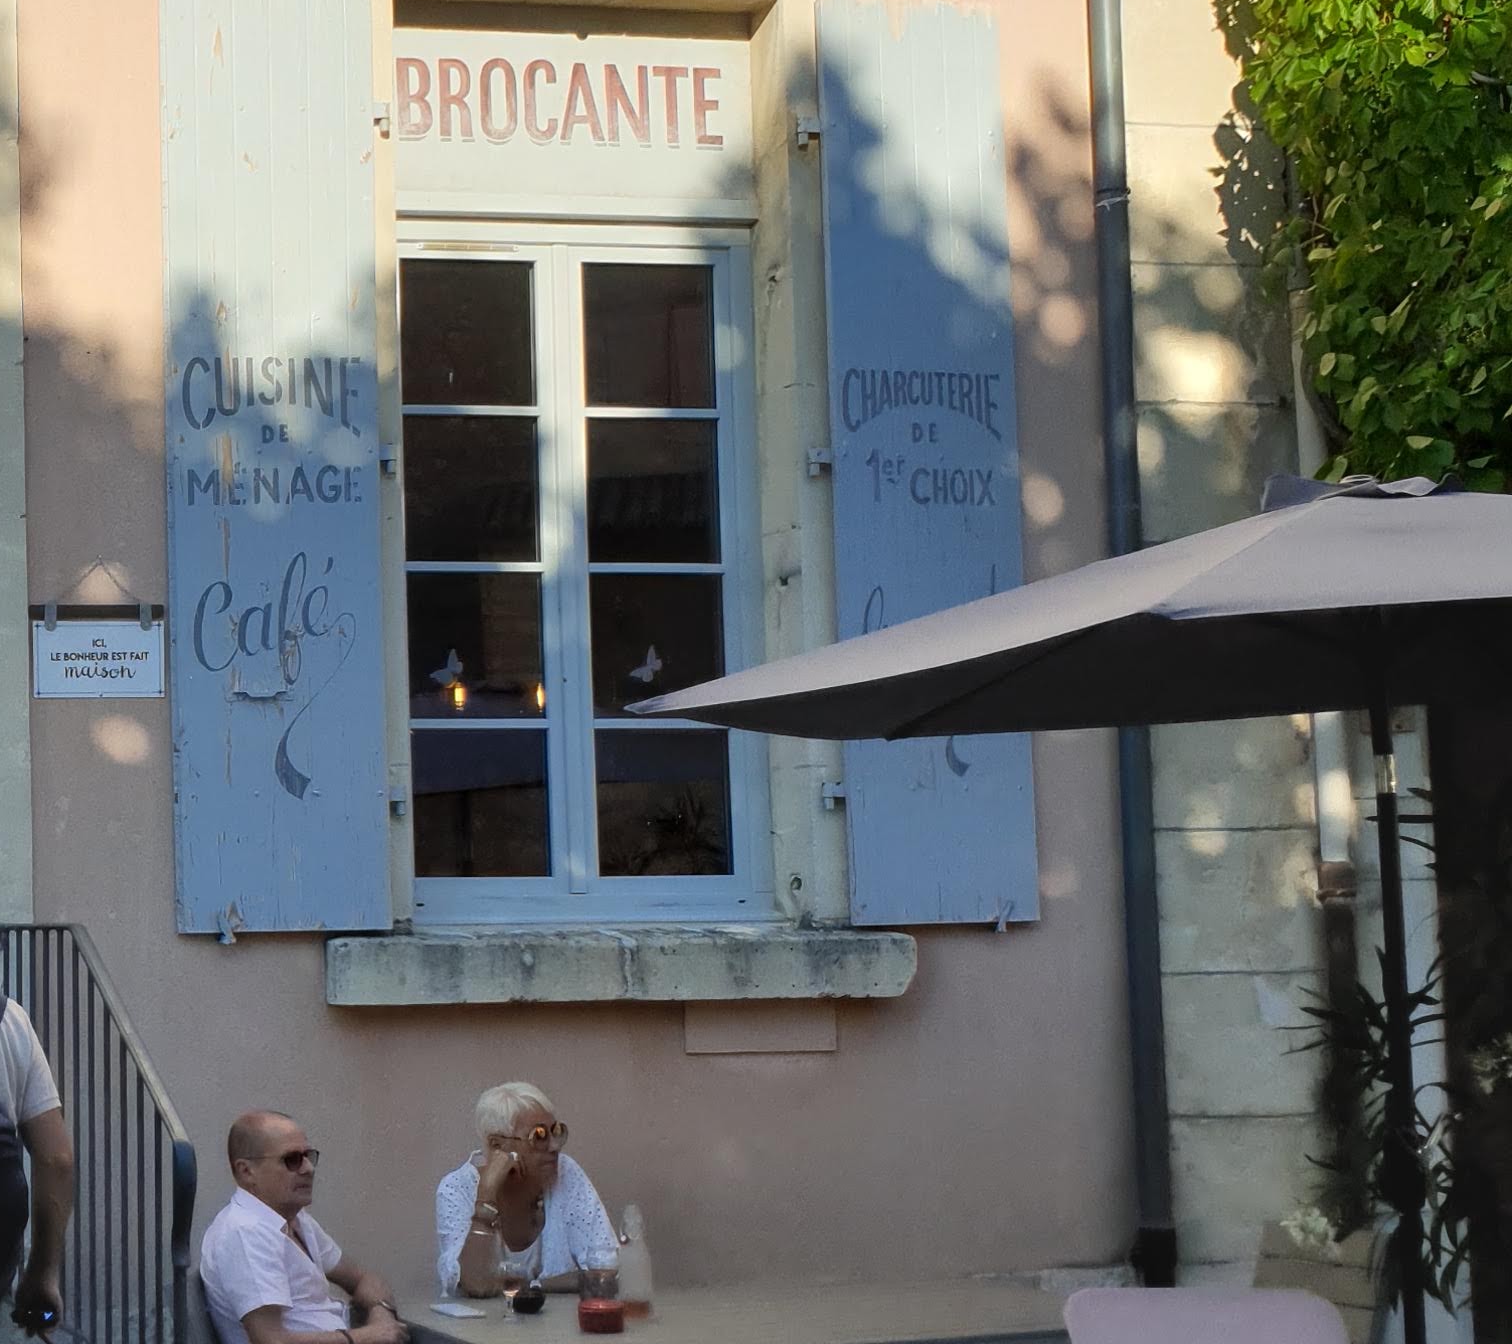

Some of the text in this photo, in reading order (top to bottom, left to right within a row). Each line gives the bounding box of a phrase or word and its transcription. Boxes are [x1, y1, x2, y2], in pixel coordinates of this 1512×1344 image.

[396, 57, 724, 148] BROCANTE
[182, 356, 361, 438] CUISINE
[842, 368, 1002, 441] CHARCUTERIE
[262, 424, 289, 443] DE
[912, 422, 938, 443] DE
[866, 449, 996, 506] 1er CHOIX
[194, 551, 354, 686] Café
[50, 651, 149, 662] LE BONHEUR EST FAIT
[65, 662, 137, 678] maison
